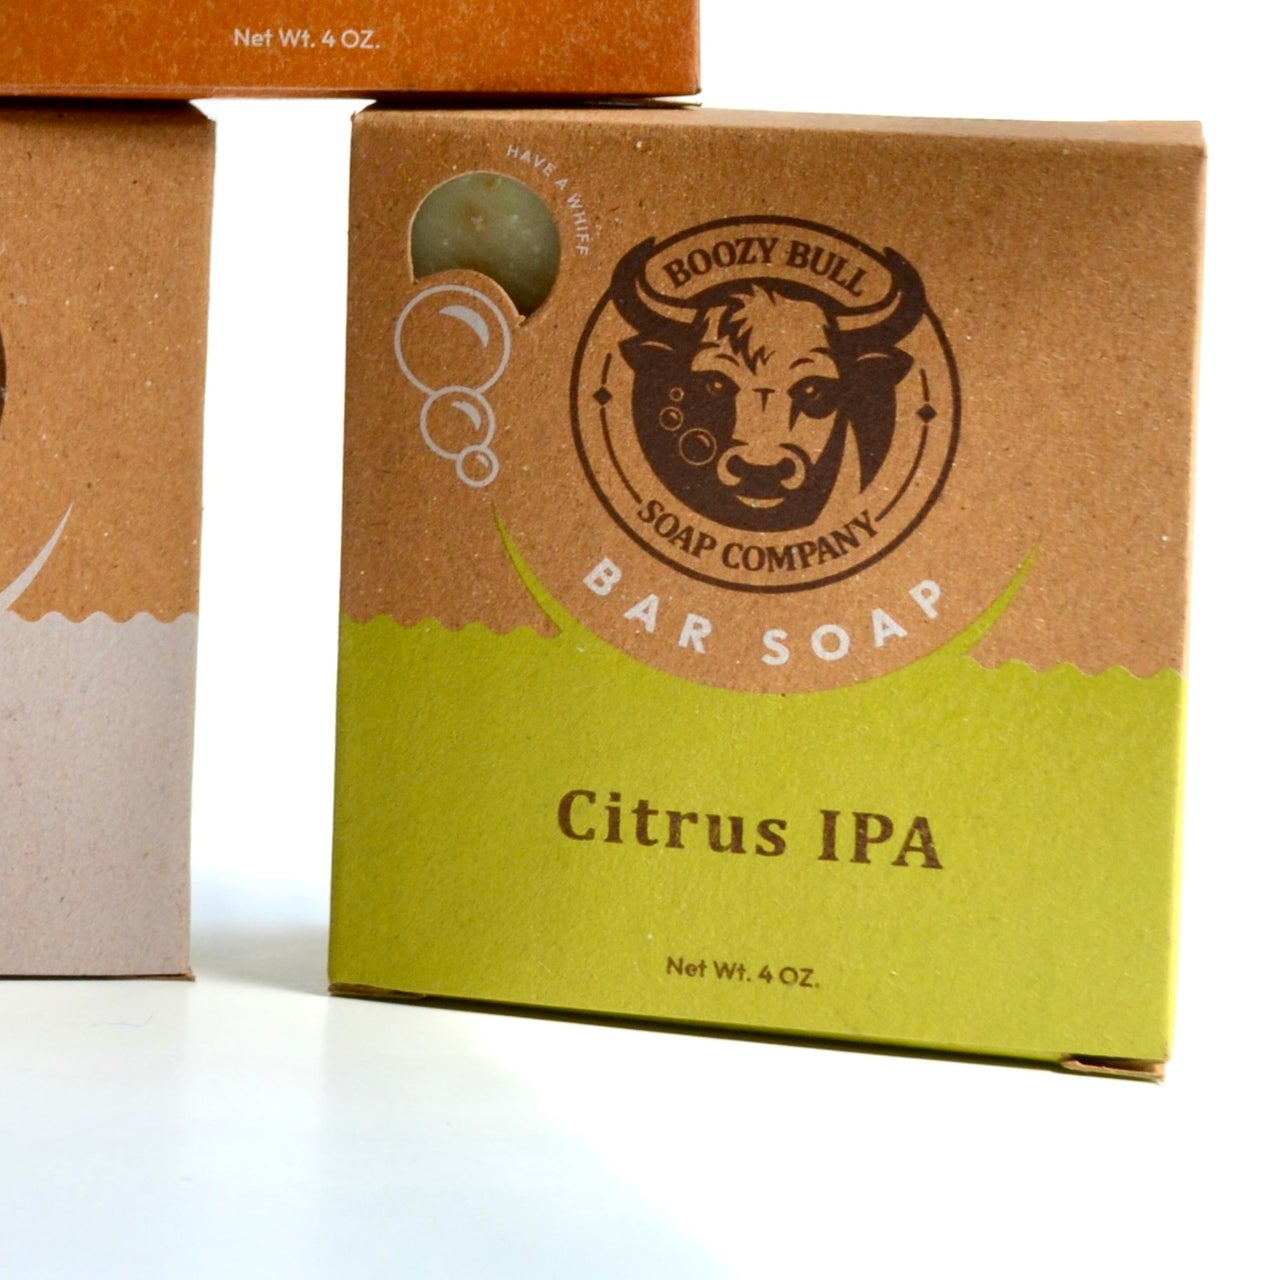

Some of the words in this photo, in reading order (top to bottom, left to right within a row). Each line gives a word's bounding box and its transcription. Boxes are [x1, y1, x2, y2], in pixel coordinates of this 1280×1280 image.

[233, 28, 273, 47] Net
[278, 29, 316, 48] Wt.
[322, 29, 336, 48] 4
[341, 29, 380, 49] OZ.
[506, 143, 557, 177] HAVE
[554, 179, 568, 191] A
[566, 193, 590, 255] WHIFF
[661, 237, 779, 290] BOOZY
[784, 239, 867, 297] BULL
[637, 499, 717, 557] SOAP
[721, 509, 879, 573] COMPANY
[582, 556, 712, 653] BAR
[760, 579, 942, 666] SOAP
[557, 789, 788, 857] Citrus
[817, 809, 944, 870] IPA
[666, 956, 707, 977] Net
[713, 960, 751, 982] Wt.
[758, 964, 773, 983] 4
[779, 967, 820, 988] OZ.
